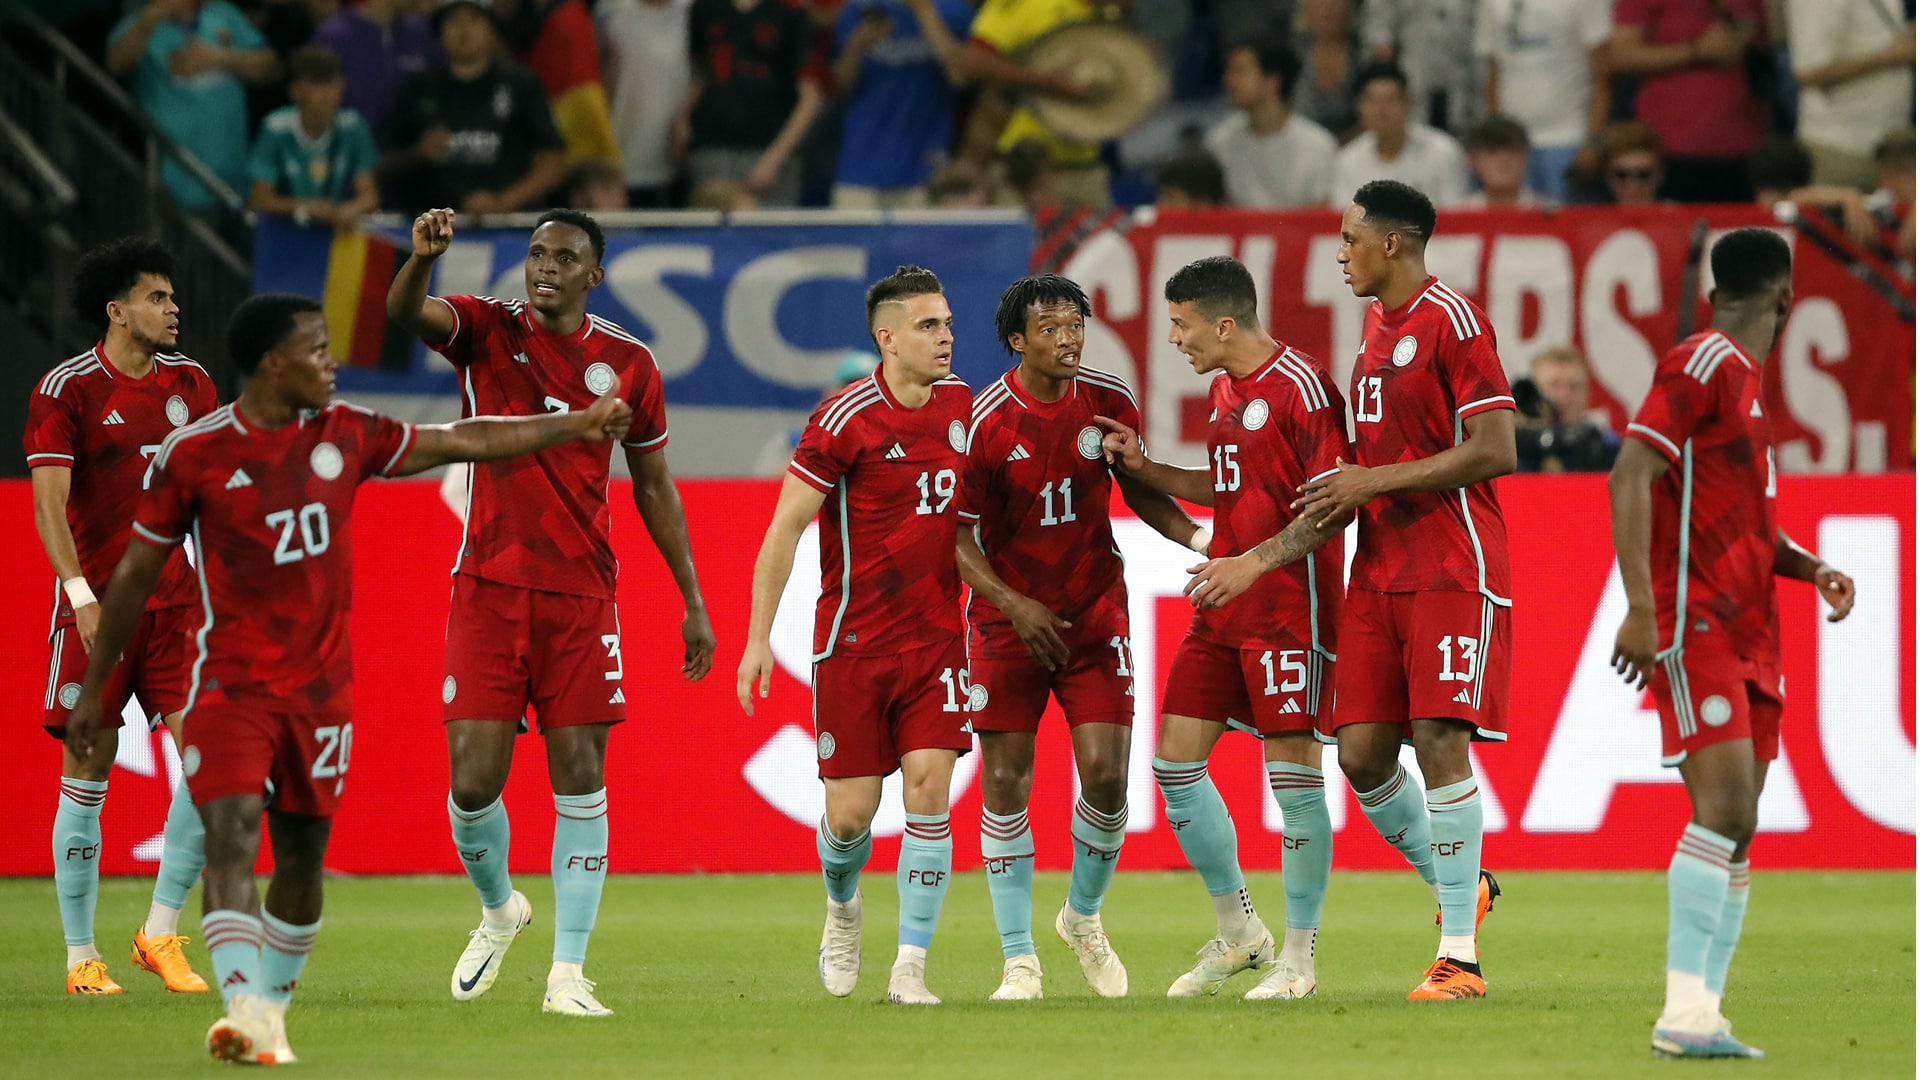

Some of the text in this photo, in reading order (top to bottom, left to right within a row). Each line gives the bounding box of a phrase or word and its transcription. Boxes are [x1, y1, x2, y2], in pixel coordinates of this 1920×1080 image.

[1356, 375, 1383, 423] 13
[915, 468, 957, 515] 19
[1213, 444, 1242, 493] 15
[1039, 477, 1077, 527] 11
[265, 501, 330, 566] 20
[601, 633, 623, 681] 3
[1259, 649, 1307, 696] 15
[1437, 635, 1479, 683] 13
[311, 721, 353, 779] 20
[908, 869, 946, 887] FCF
